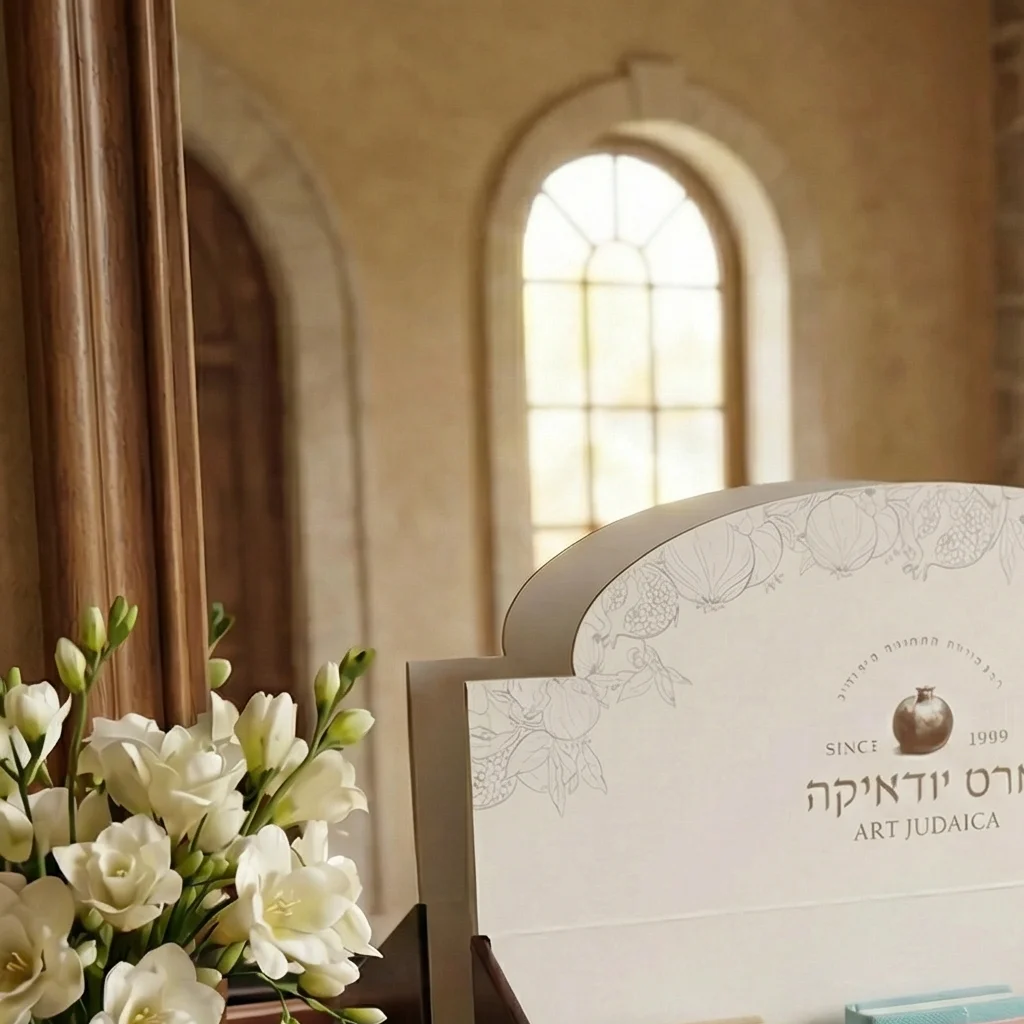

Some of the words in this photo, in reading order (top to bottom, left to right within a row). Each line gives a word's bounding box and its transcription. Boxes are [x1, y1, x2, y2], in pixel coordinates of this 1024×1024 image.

[825, 740, 877, 756] SINCE
[969, 730, 1008, 746] 1999
[806, 769, 950, 818] יודאיקה
[853, 820, 900, 841] ART
[905, 812, 998, 841] JUDAICA
